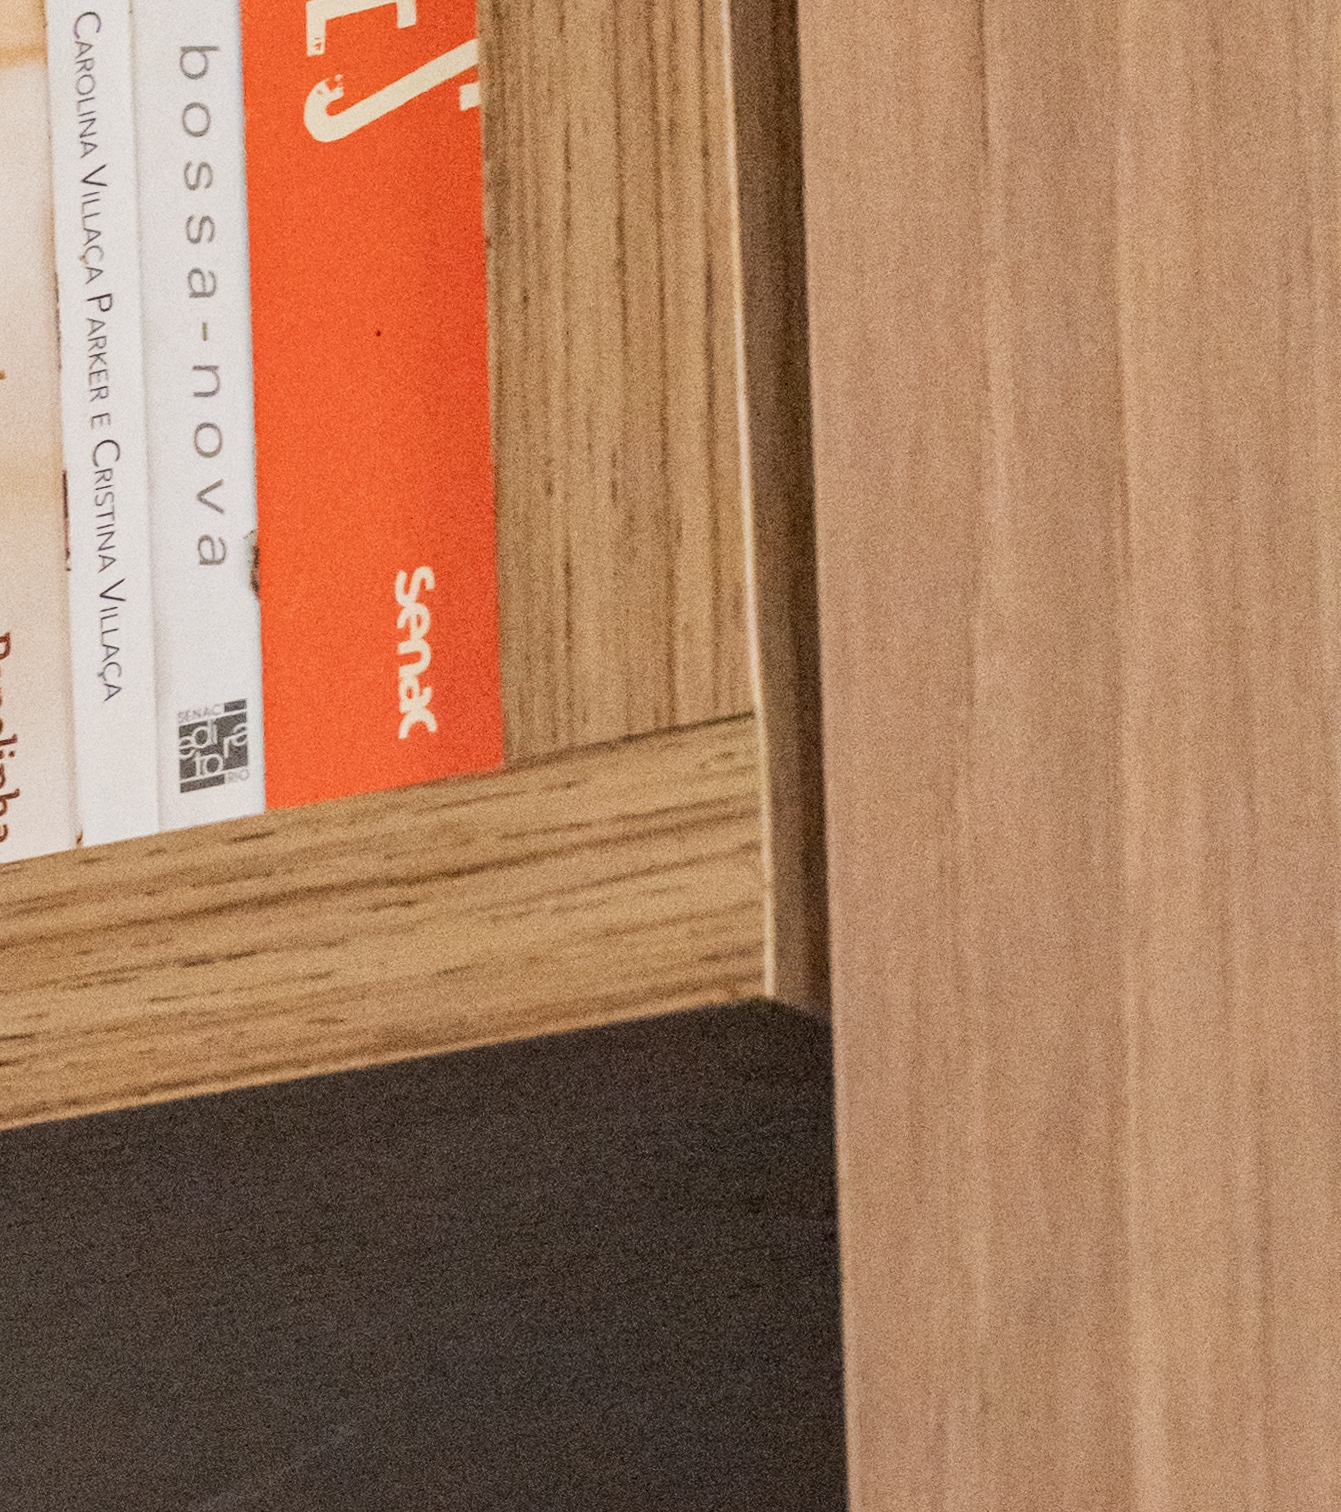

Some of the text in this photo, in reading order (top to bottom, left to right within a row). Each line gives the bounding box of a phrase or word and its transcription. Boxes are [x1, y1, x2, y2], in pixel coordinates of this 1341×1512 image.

[72, 10, 104, 159] CAROLINA
[79, 163, 108, 285] VILLAÇA
[86, 292, 115, 403] PARKER
[178, 43, 229, 569] bossa-nova
[92, 437, 122, 574] CRISTINA
[96, 578, 128, 703] VILLAÇA
